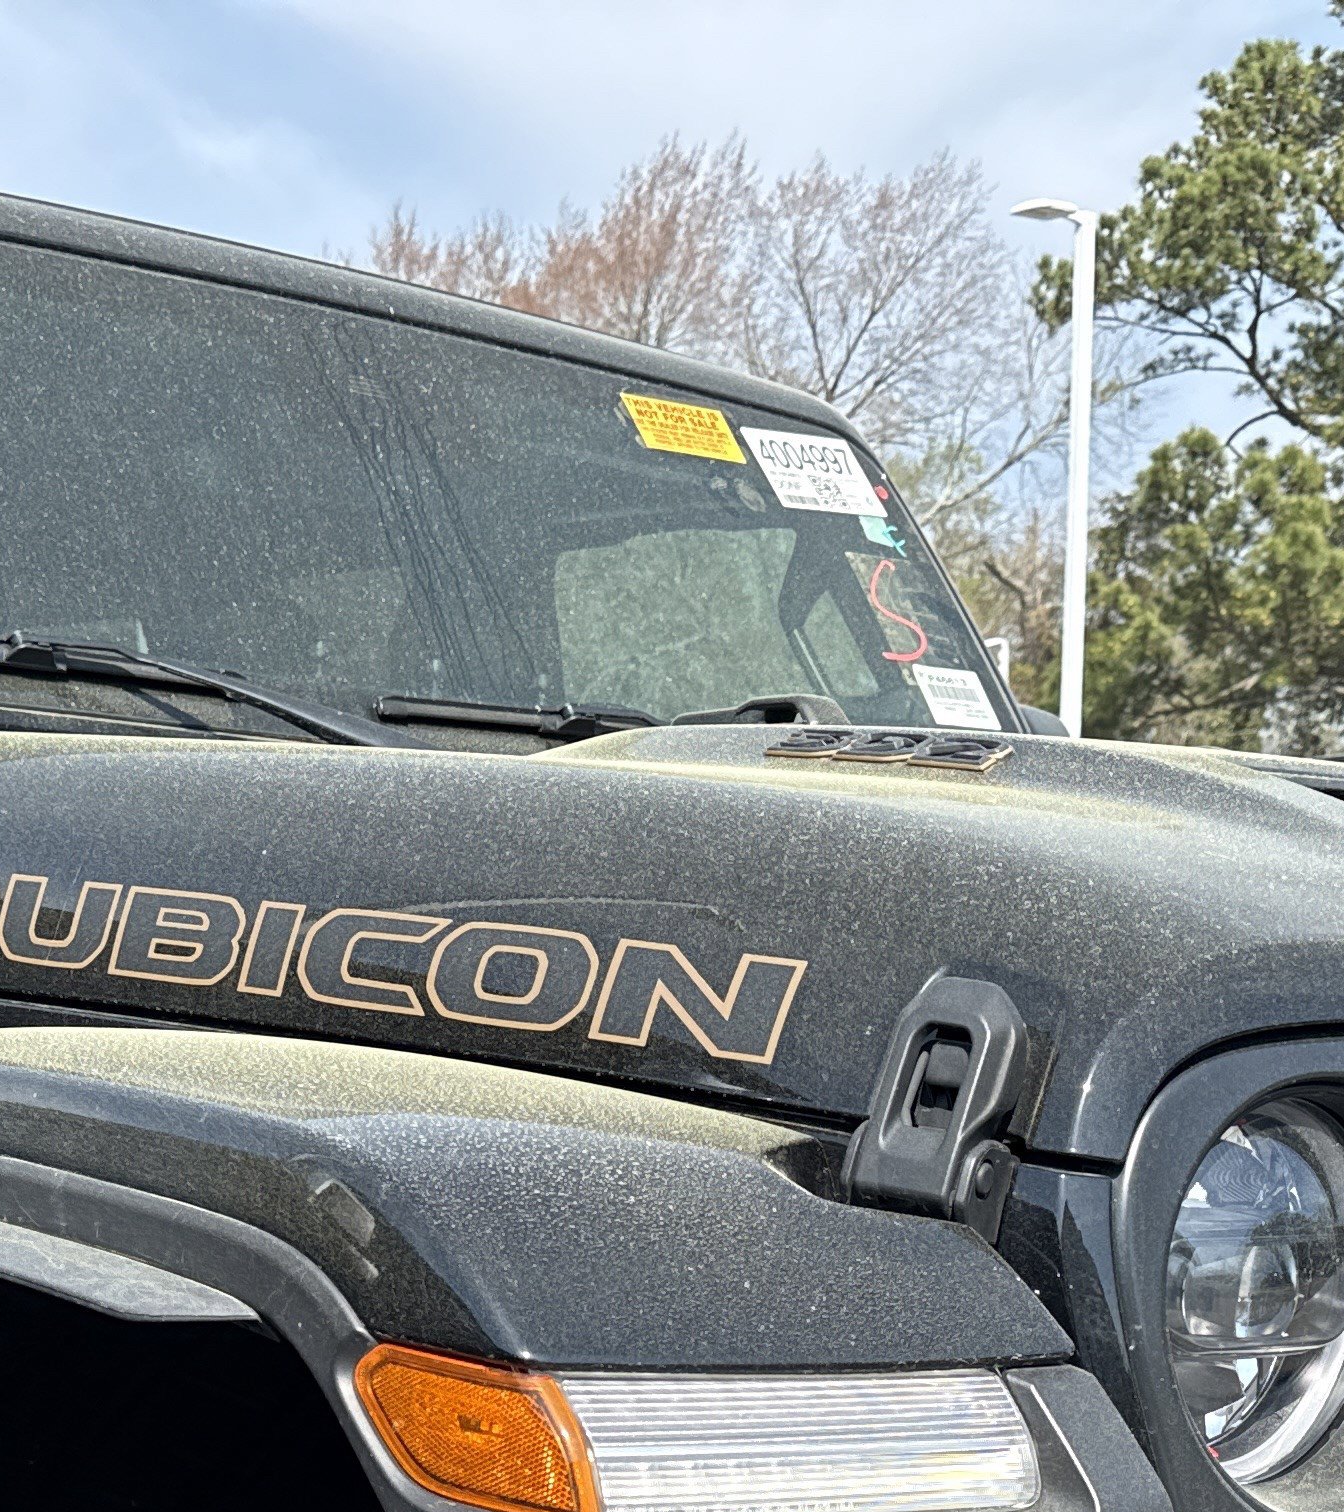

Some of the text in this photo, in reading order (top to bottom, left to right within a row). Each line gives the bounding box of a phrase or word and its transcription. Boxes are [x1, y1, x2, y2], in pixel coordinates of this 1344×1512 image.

[635, 408, 659, 420] NOT
[662, 412, 687, 424] FOR
[689, 417, 720, 430] SALE
[655, 402, 705, 419] VEHICLE
[759, 438, 853, 476] 4004997
[869, 559, 928, 662] S
